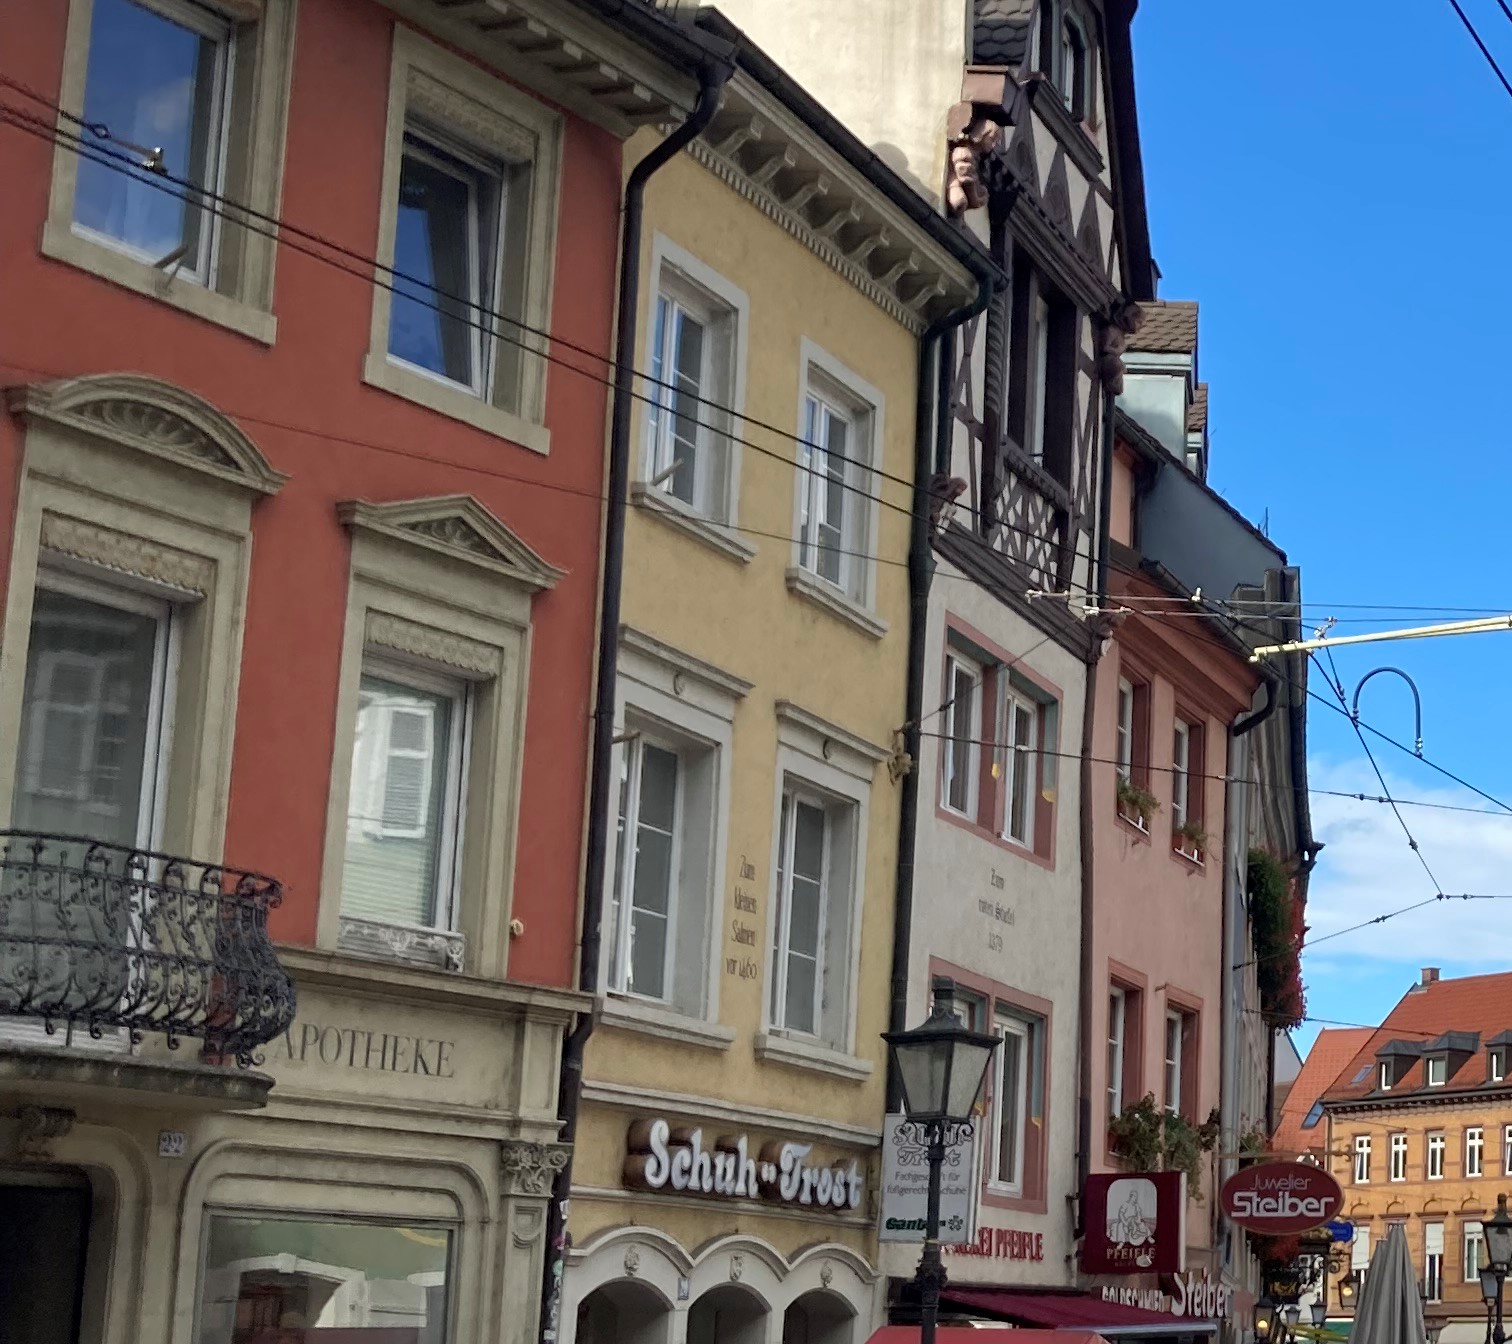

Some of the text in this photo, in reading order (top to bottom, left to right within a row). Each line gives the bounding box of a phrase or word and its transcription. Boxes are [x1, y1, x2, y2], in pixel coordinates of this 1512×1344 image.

[1250, 1174, 1312, 1190] Juwelier
[1231, 1191, 1334, 1217] Steiber
[995, 1228, 1044, 1260] PFEIFLE
[1106, 1248, 1156, 1260] PFEIFLE
[1171, 1267, 1233, 1317] Steiber
